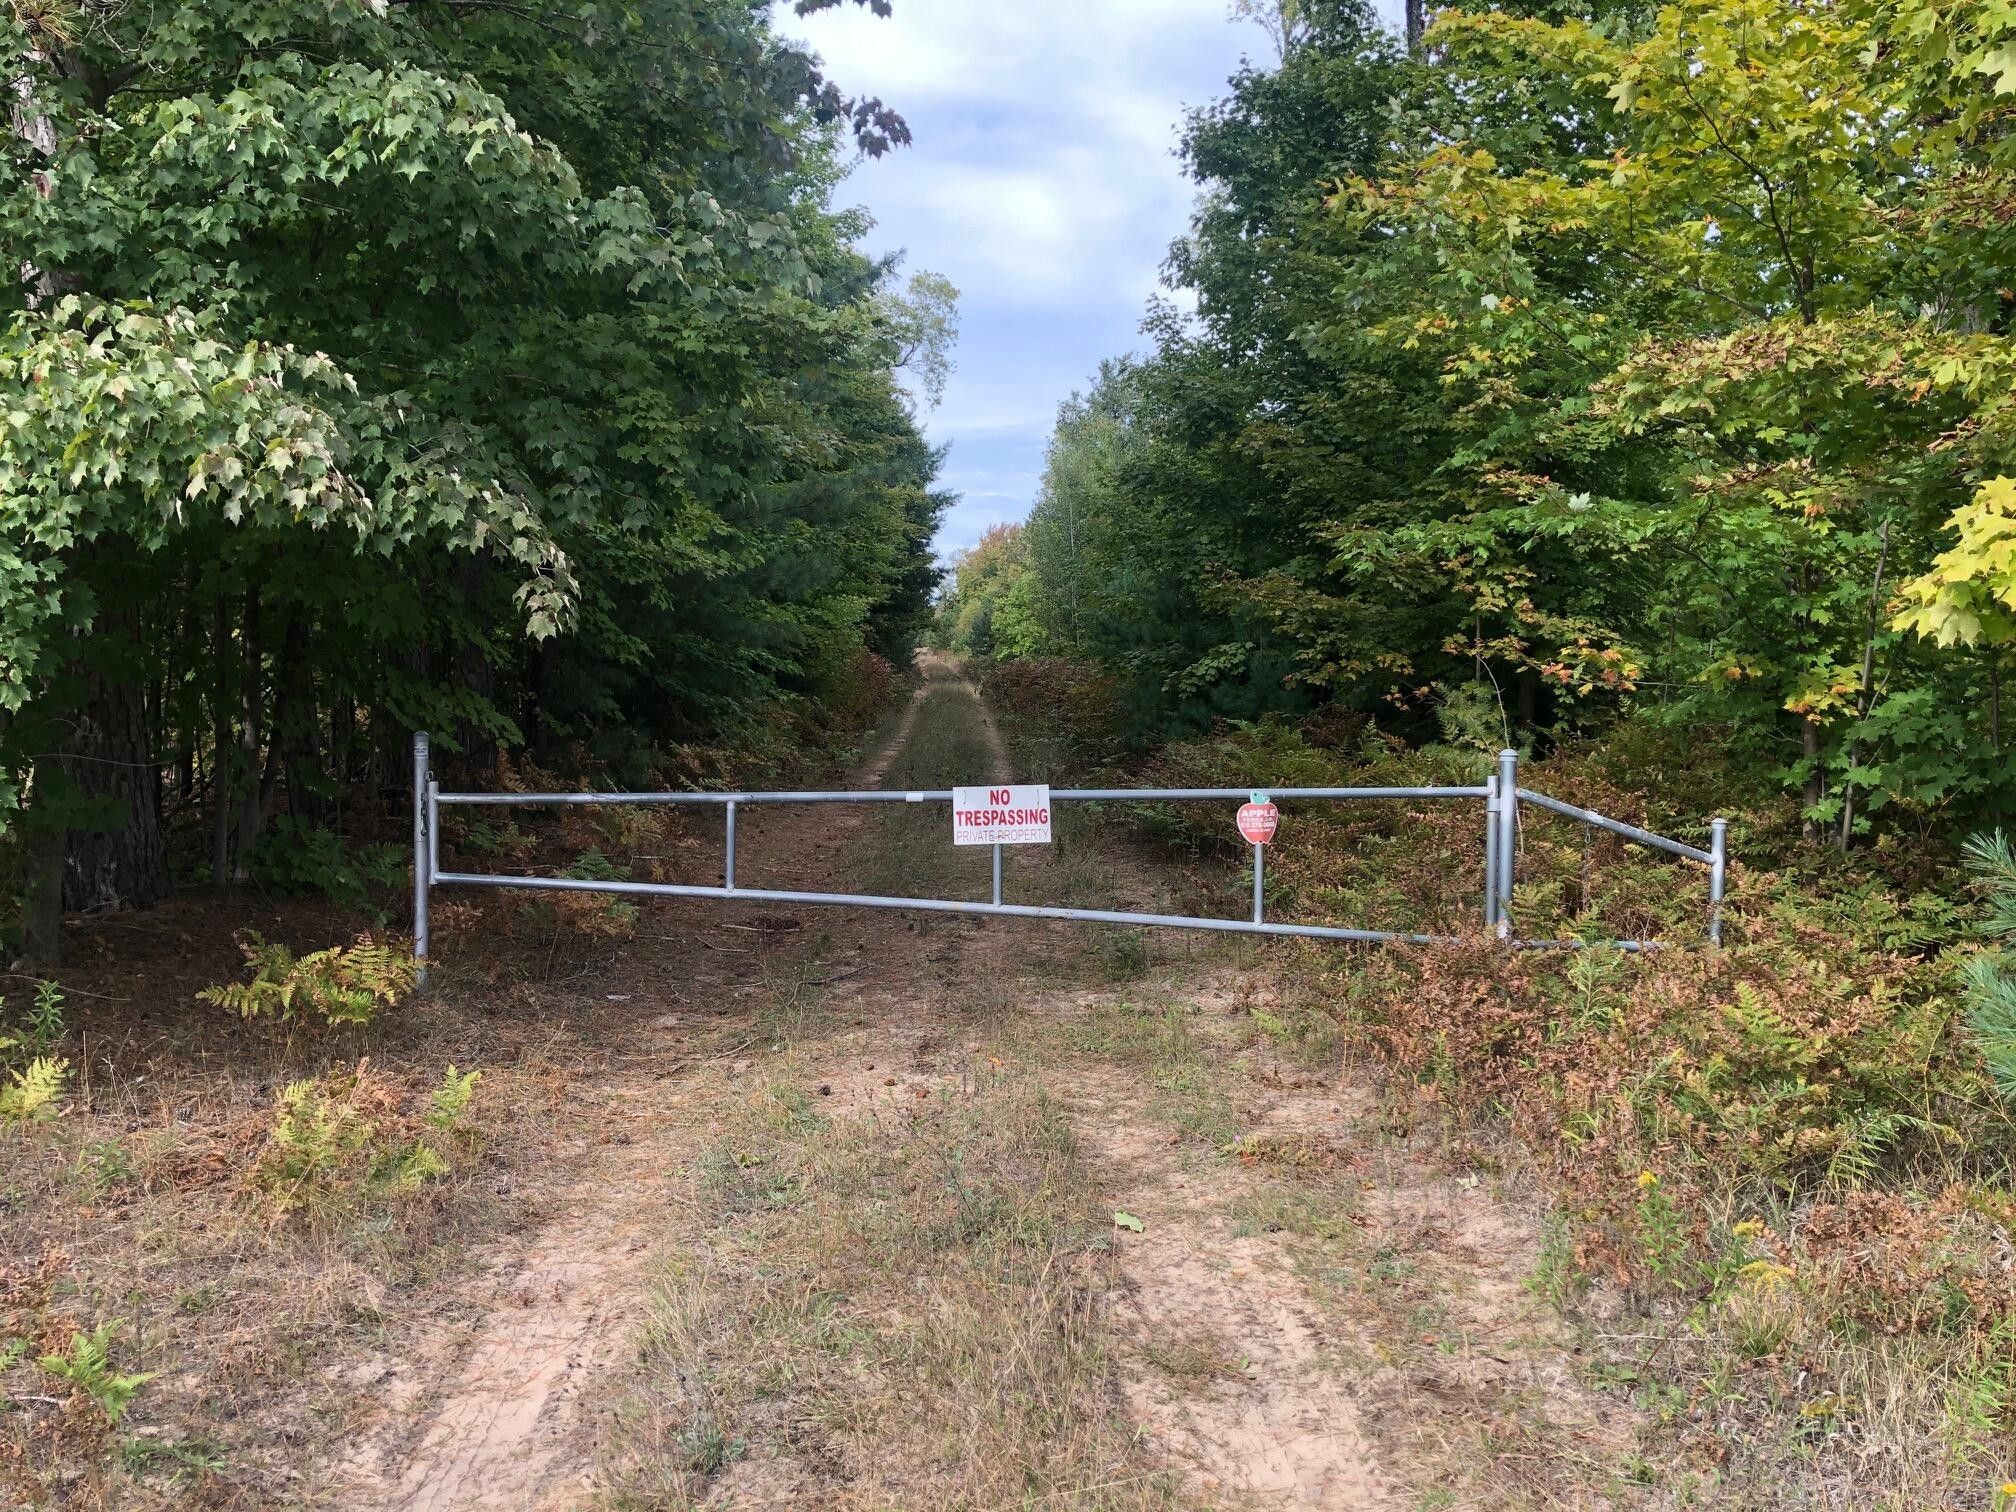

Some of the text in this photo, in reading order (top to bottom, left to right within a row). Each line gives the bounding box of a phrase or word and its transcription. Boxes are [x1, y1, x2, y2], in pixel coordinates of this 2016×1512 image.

[990, 789, 1010, 806] NO
[956, 808, 1048, 827] TRESPASSING
[1241, 809, 1276, 817] APPLE
[956, 828, 1048, 842] PRIVATE PROPERTY
